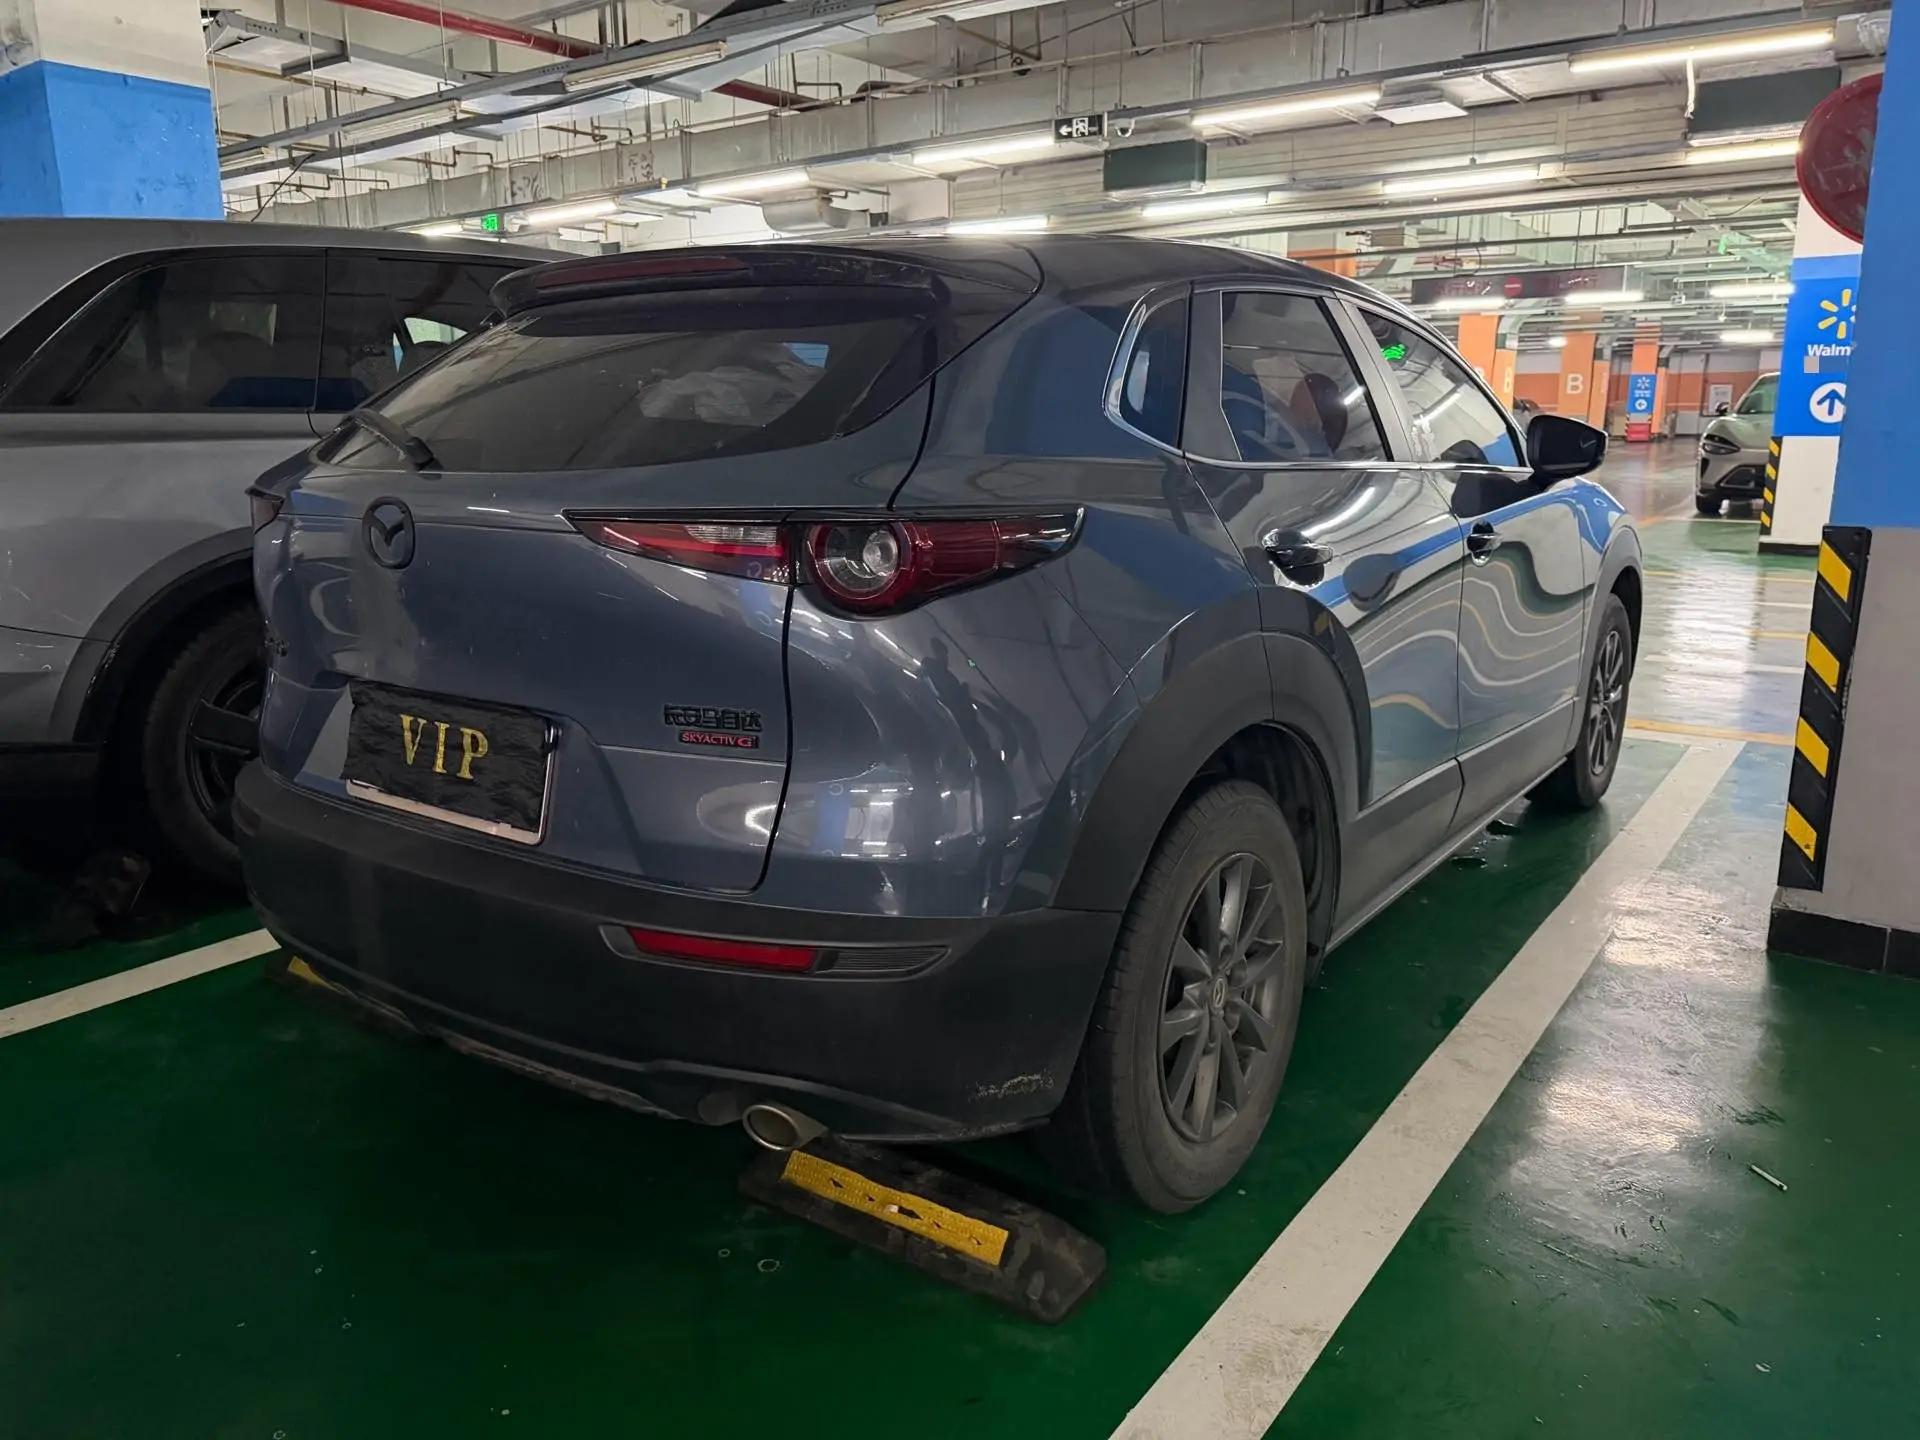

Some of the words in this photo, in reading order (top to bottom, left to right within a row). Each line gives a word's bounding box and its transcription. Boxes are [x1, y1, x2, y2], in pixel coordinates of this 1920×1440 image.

[1807, 344, 1852, 357] Walm
[1566, 373, 1584, 394] B
[400, 714, 489, 779] VIP
